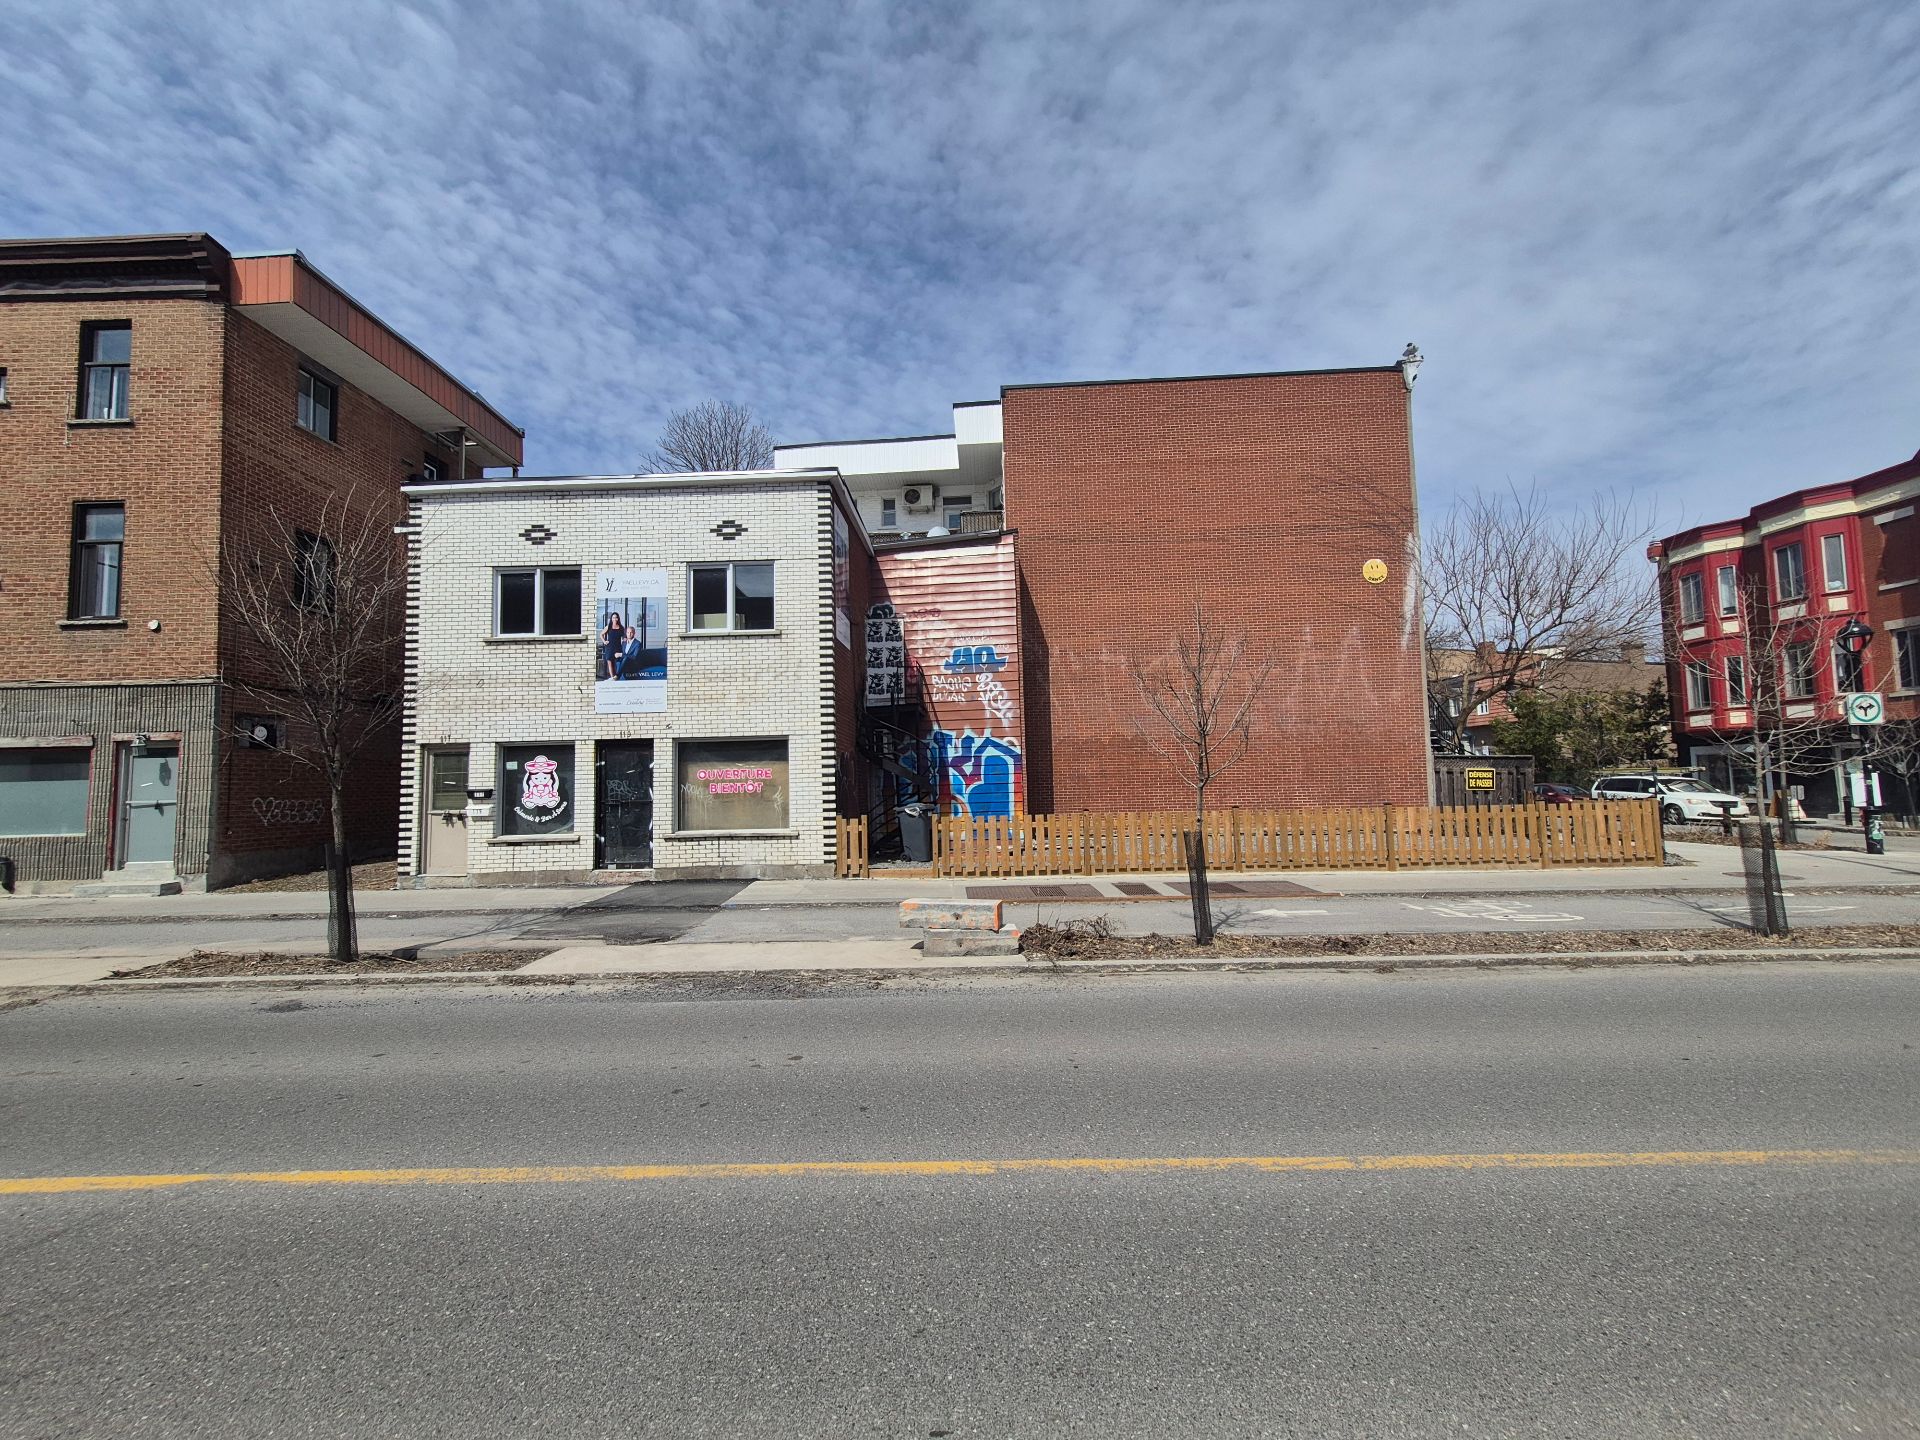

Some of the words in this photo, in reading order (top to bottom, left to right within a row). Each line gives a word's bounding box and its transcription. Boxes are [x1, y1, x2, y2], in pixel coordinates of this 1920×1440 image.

[697, 768, 773, 780] OUVERTURE
[709, 780, 763, 794] BIENTÔT
[1470, 779, 1476, 787] DE
[1476, 779, 1493, 787] PASSER
